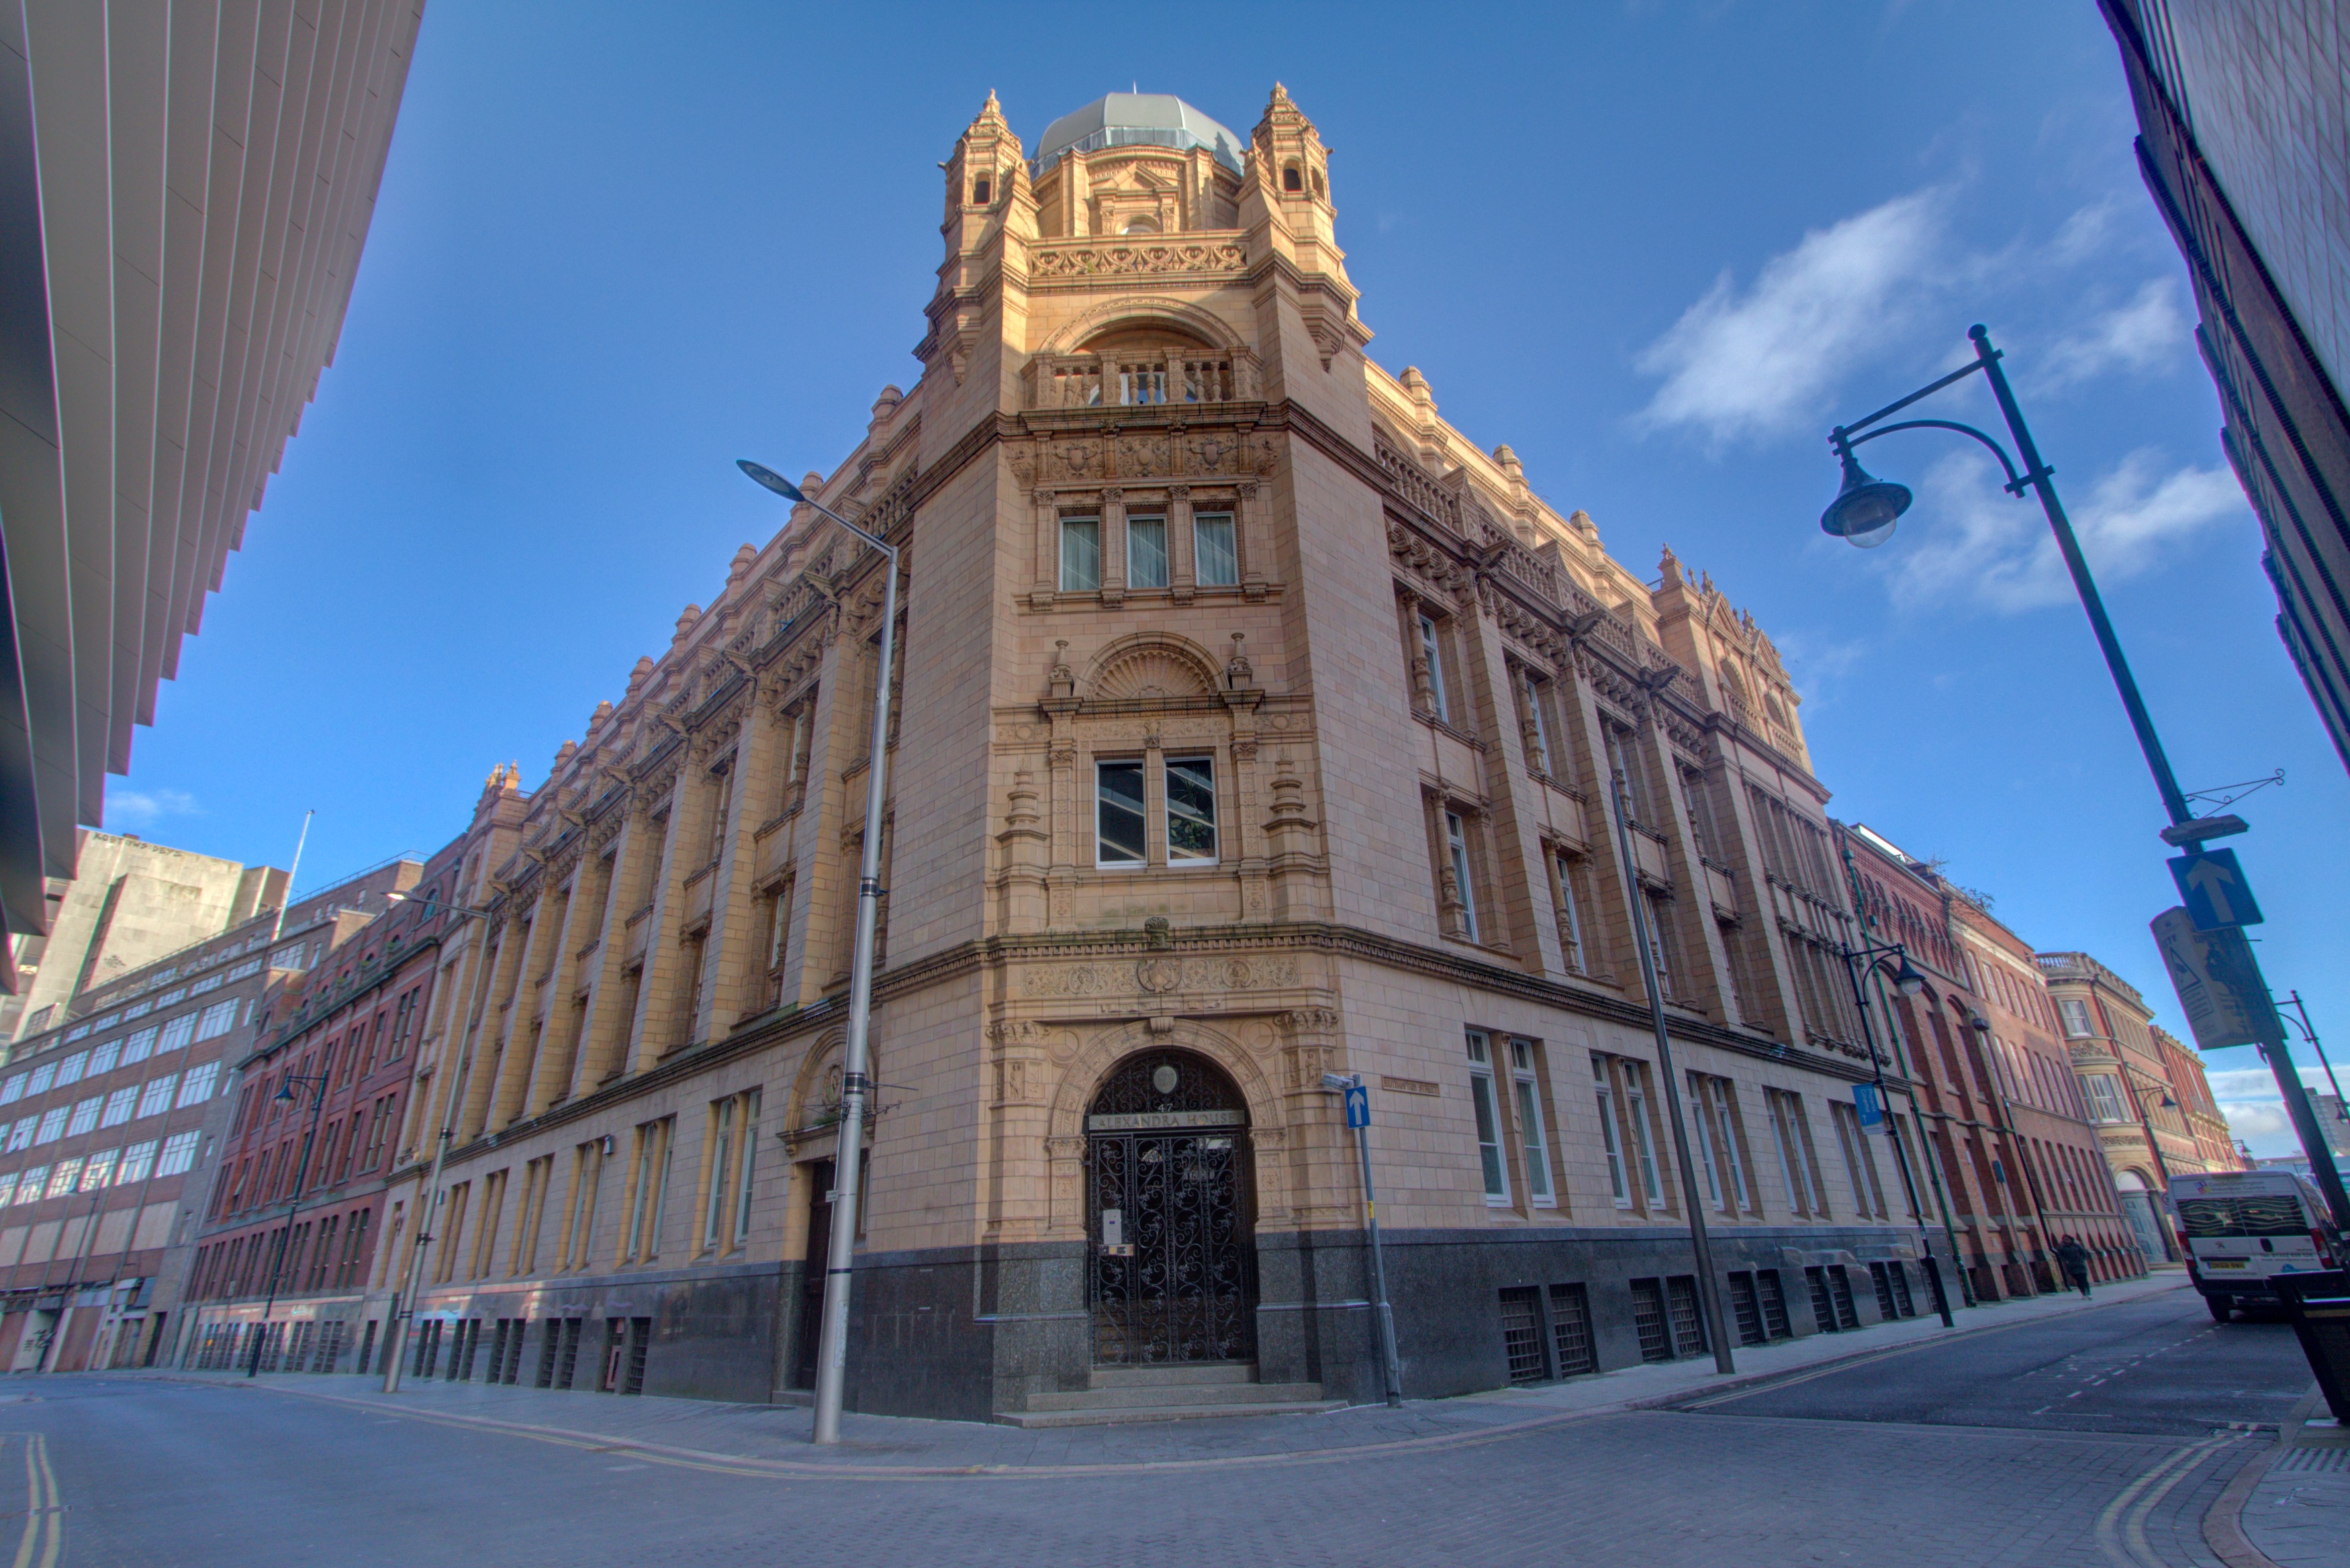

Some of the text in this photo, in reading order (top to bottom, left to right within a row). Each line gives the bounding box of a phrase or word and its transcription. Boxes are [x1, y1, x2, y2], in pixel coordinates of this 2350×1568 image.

[1383, 1078, 1440, 1095] SOUTHAMPTON STREET
[1158, 1103, 1173, 1113] 47
[1860, 1089, 1871, 1113] Cinema
[1868, 1088, 1877, 1112] Phoenix
[1098, 1112, 1235, 1128] ALEXANDRA HOUSE
